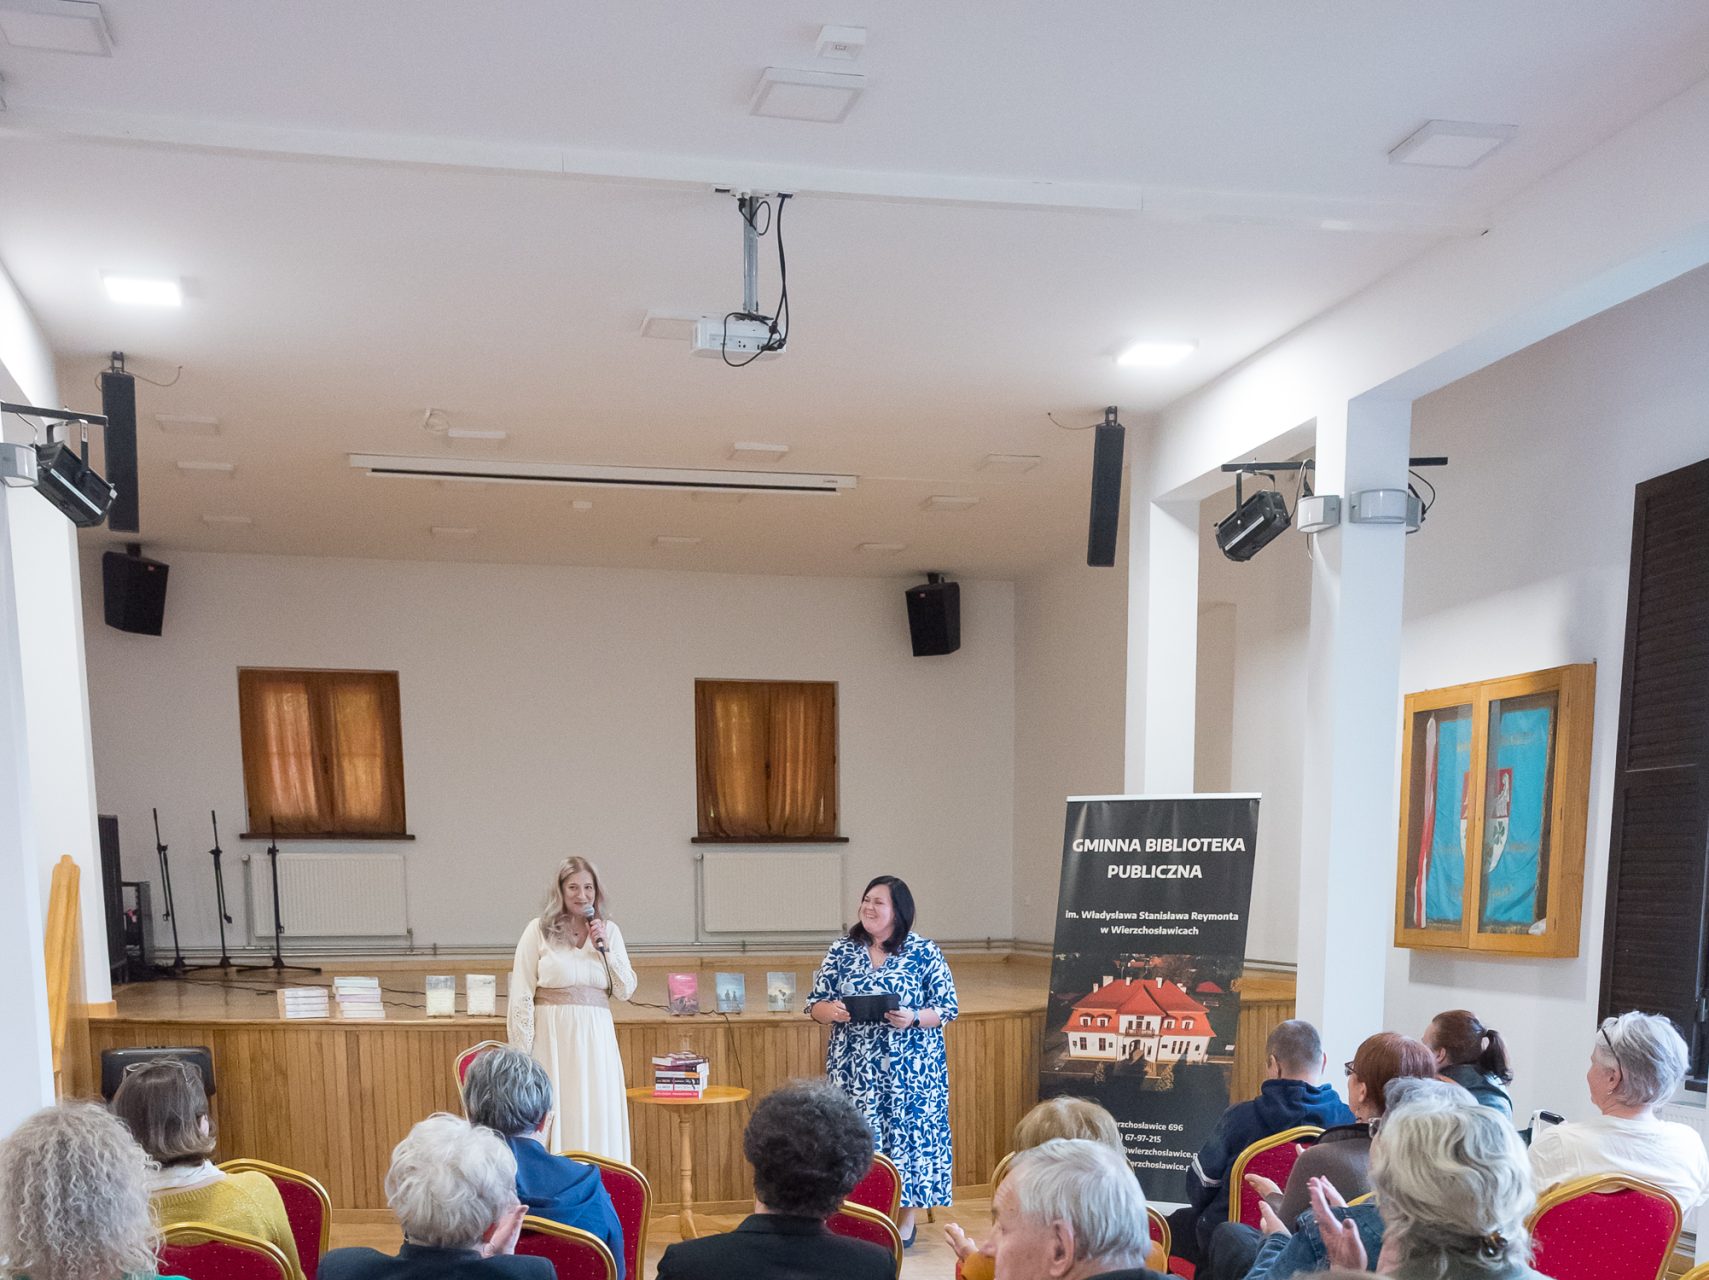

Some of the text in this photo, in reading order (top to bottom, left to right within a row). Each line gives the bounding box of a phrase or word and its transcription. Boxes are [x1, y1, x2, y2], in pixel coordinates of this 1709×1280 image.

[1072, 837, 1246, 852] GMINNA BIBLIOTEKA
[1107, 864, 1203, 879] PUBLICZNA
[1065, 910, 1239, 922] im. Władysława Stanisława Reymonta
[1100, 925, 1200, 935] w Wierzchosławicach
[1168, 1123, 1184, 1132] 696
[1124, 1134, 1162, 1143] 67-97-215
